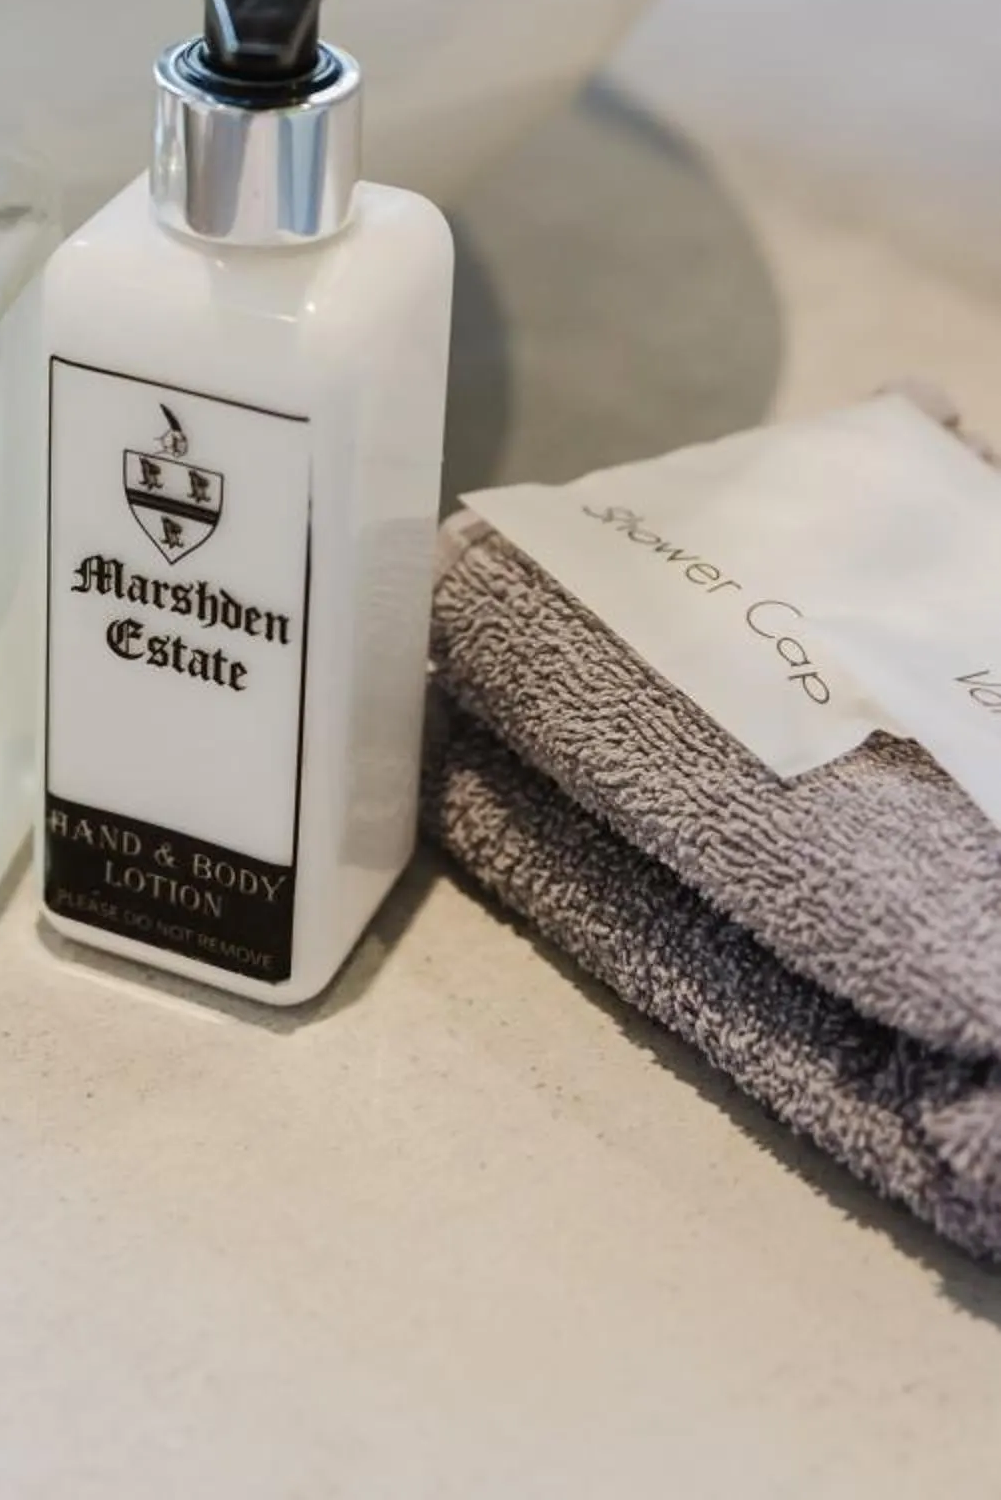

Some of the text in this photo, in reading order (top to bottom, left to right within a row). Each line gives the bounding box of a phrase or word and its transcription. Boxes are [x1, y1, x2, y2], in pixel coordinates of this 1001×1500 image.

[70, 554, 291, 645] Marshden
[582, 505, 830, 704] Shower Cap
[106, 617, 249, 693] Estate
[49, 809, 287, 902] HAND & BODY
[104, 860, 223, 918] LOTION
[57, 888, 274, 969] PLEASE DO NOT REMOVE
